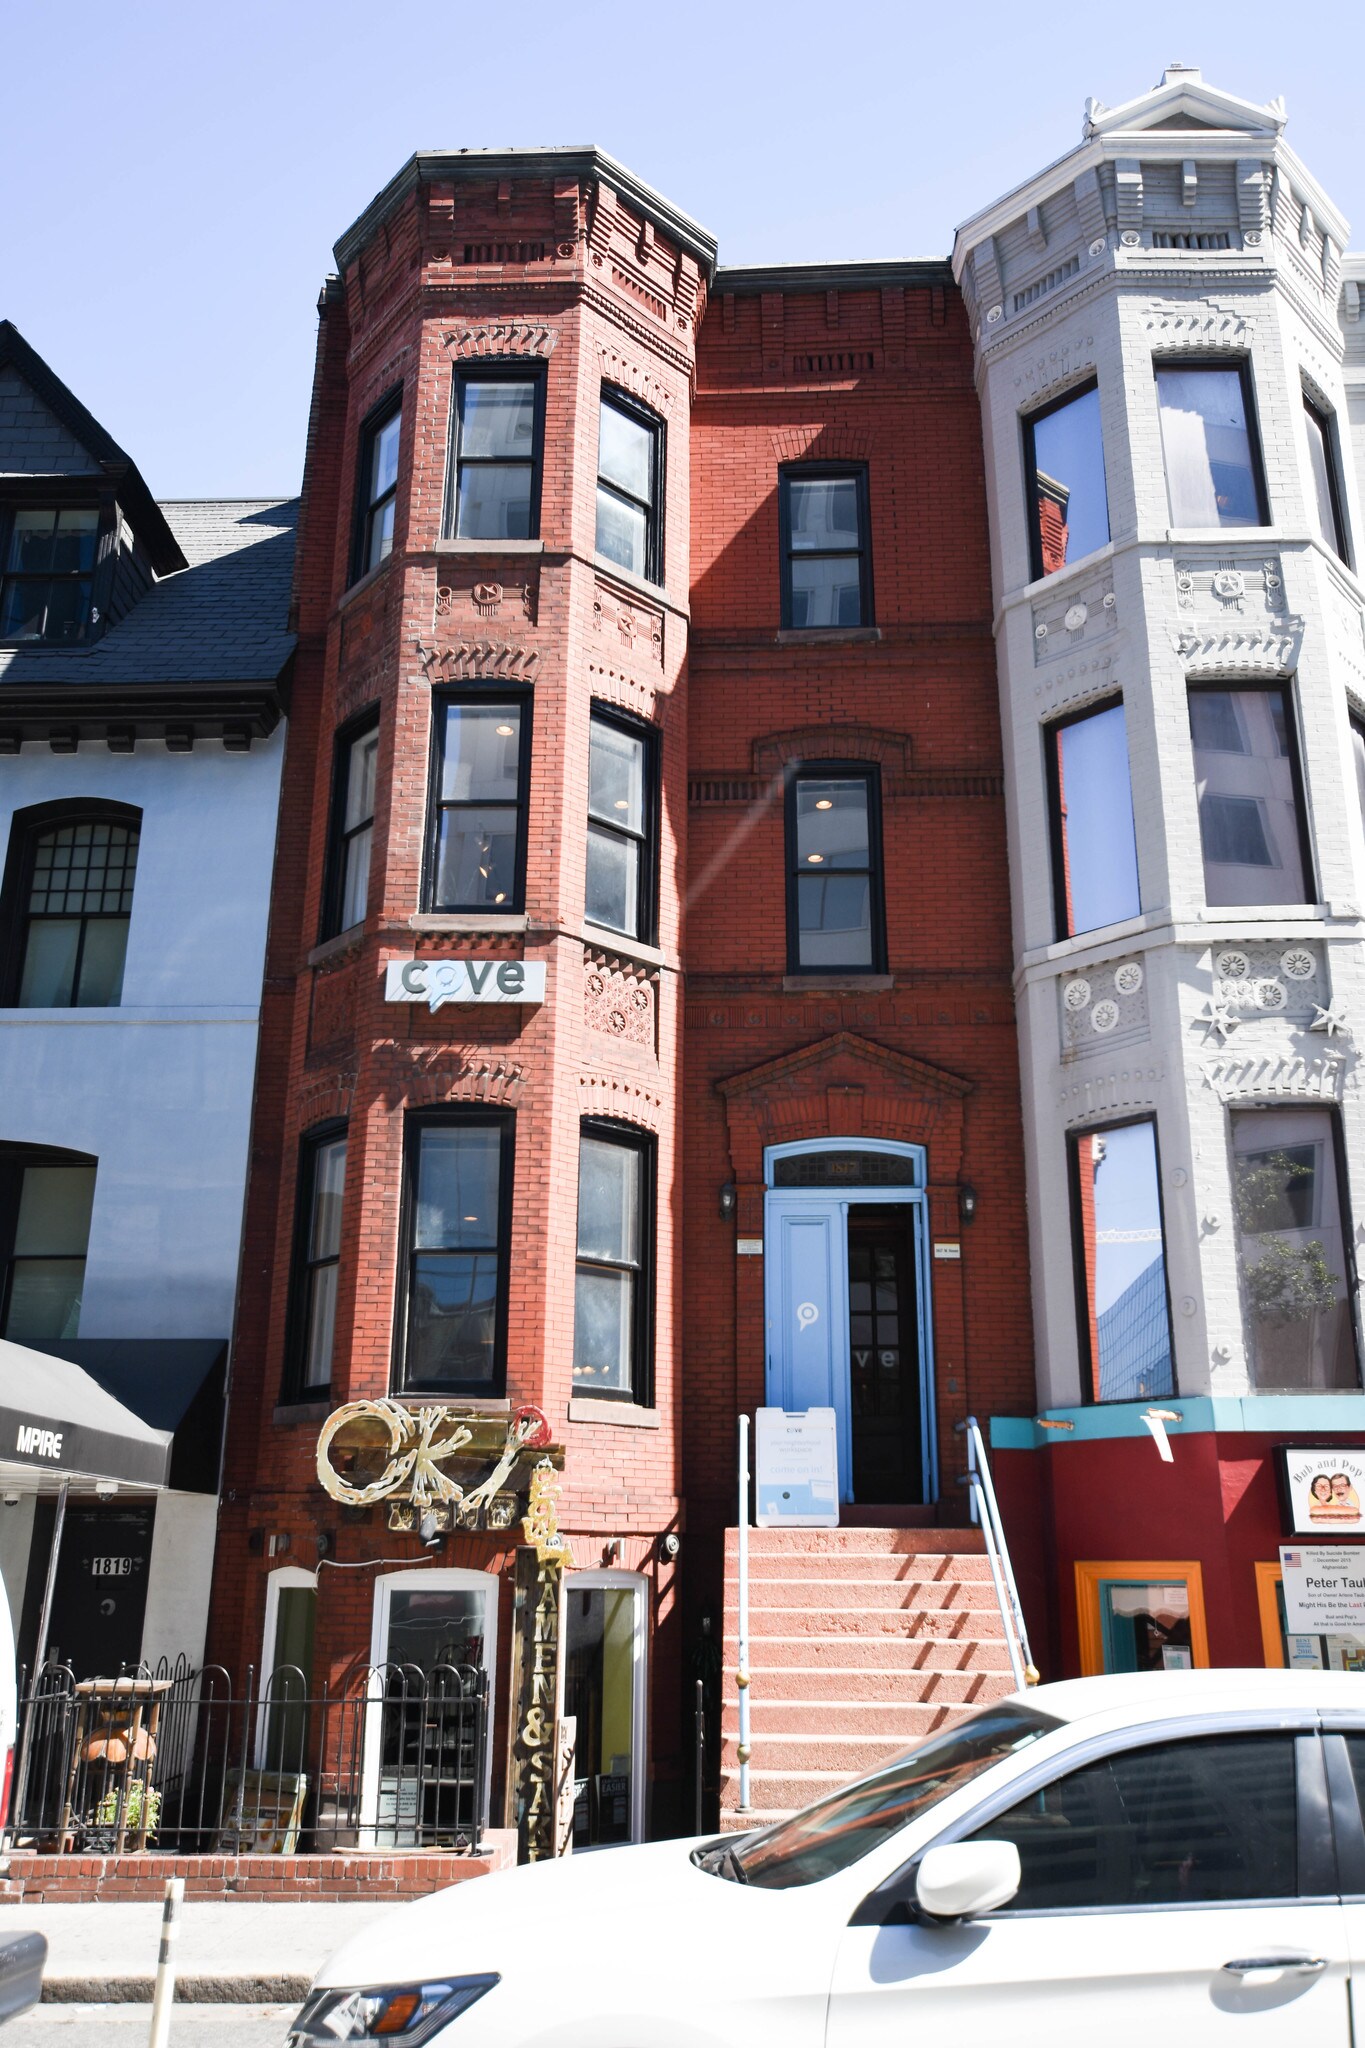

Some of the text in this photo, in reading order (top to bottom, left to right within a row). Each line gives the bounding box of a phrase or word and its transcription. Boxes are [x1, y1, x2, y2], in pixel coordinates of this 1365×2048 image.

[402, 960, 525, 1014] cove
[16, 1425, 63, 1459] MPIRE
[769, 1466, 796, 1474] come
[796, 1466, 810, 1474] on
[1293, 1464, 1313, 1483] Bub
[1317, 1458, 1337, 1469] and
[94, 1558, 131, 1574] 1819
[1306, 1577, 1338, 1588] Peter
[522, 1707, 555, 1747] &
